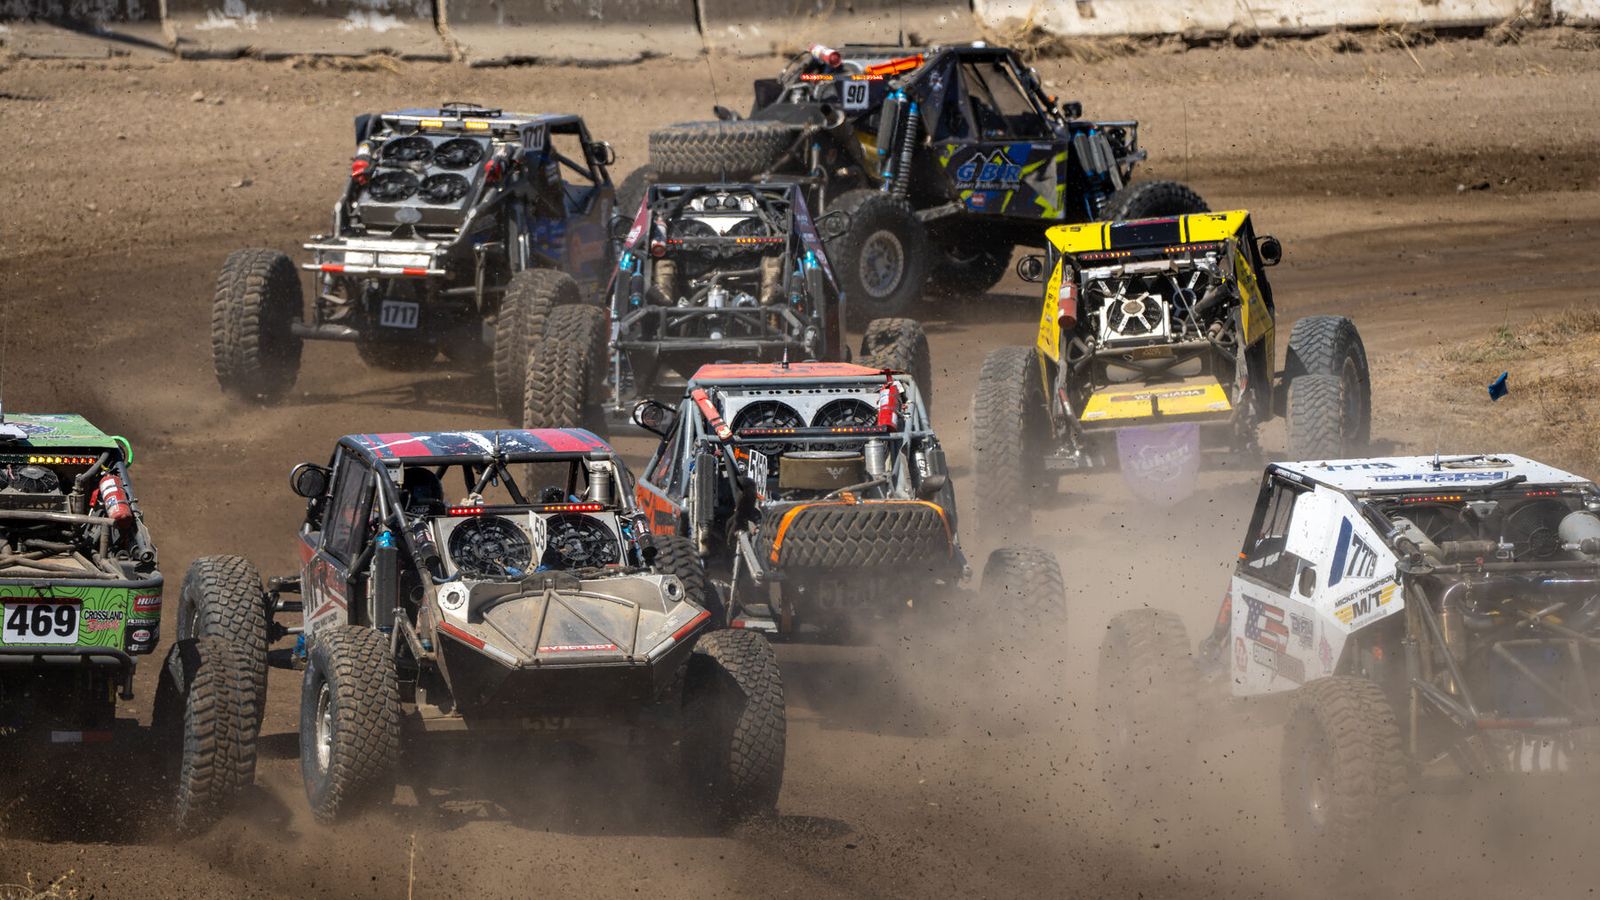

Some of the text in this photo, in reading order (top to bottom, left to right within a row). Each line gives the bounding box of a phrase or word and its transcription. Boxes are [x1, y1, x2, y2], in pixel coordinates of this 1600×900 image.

[847, 85, 865, 103] 90
[384, 305, 416, 325] 1717
[535, 517, 545, 551] 59
[1335, 573, 1395, 608] MICKEY THOMPSON
[6, 605, 77, 637] 469
[84, 610, 124, 620] CROSSLAND
